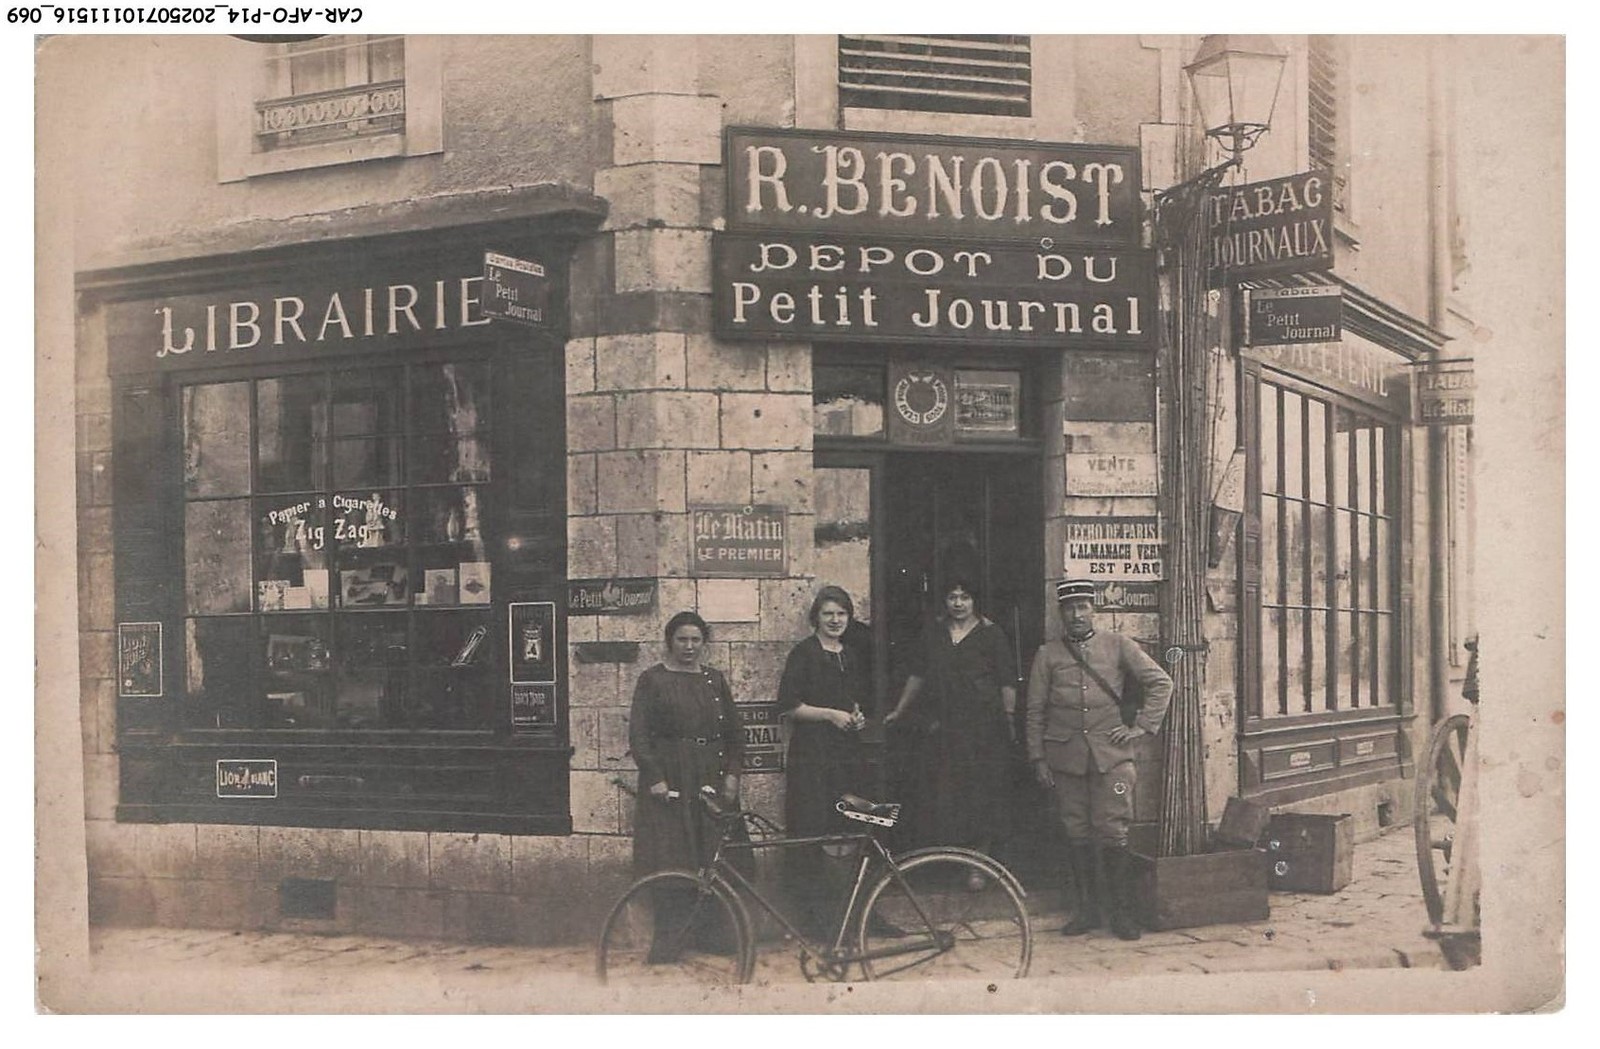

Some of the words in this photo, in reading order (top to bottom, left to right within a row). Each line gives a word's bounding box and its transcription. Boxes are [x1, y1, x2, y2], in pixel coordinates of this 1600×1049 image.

[811, 144, 1124, 225] BENOIST
[1210, 177, 1322, 227] TABAC
[1209, 219, 1328, 270] JOURNAUX
[750, 243, 992, 277] DEPOT
[1037, 253, 1117, 283] DU
[155, 276, 492, 358] LIBRAIRIE
[505, 302, 542, 322] Journal
[732, 282, 879, 327] Petit
[912, 289, 1143, 335] Journal
[1257, 300, 1273, 314] Le
[1267, 313, 1299, 327] Petit
[1282, 325, 1335, 339] Journal
[1088, 458, 1136, 472] VENTE
[269, 501, 310, 525] Papier
[295, 519, 325, 550] Zig
[334, 518, 369, 548] Zag
[695, 511, 720, 542] Le
[721, 512, 783, 540] Matin
[1123, 523, 1157, 539] PARIS
[718, 547, 782, 561] PREMIER
[1070, 543, 1131, 560] L'ALMANACH
[1089, 562, 1116, 574] EST
